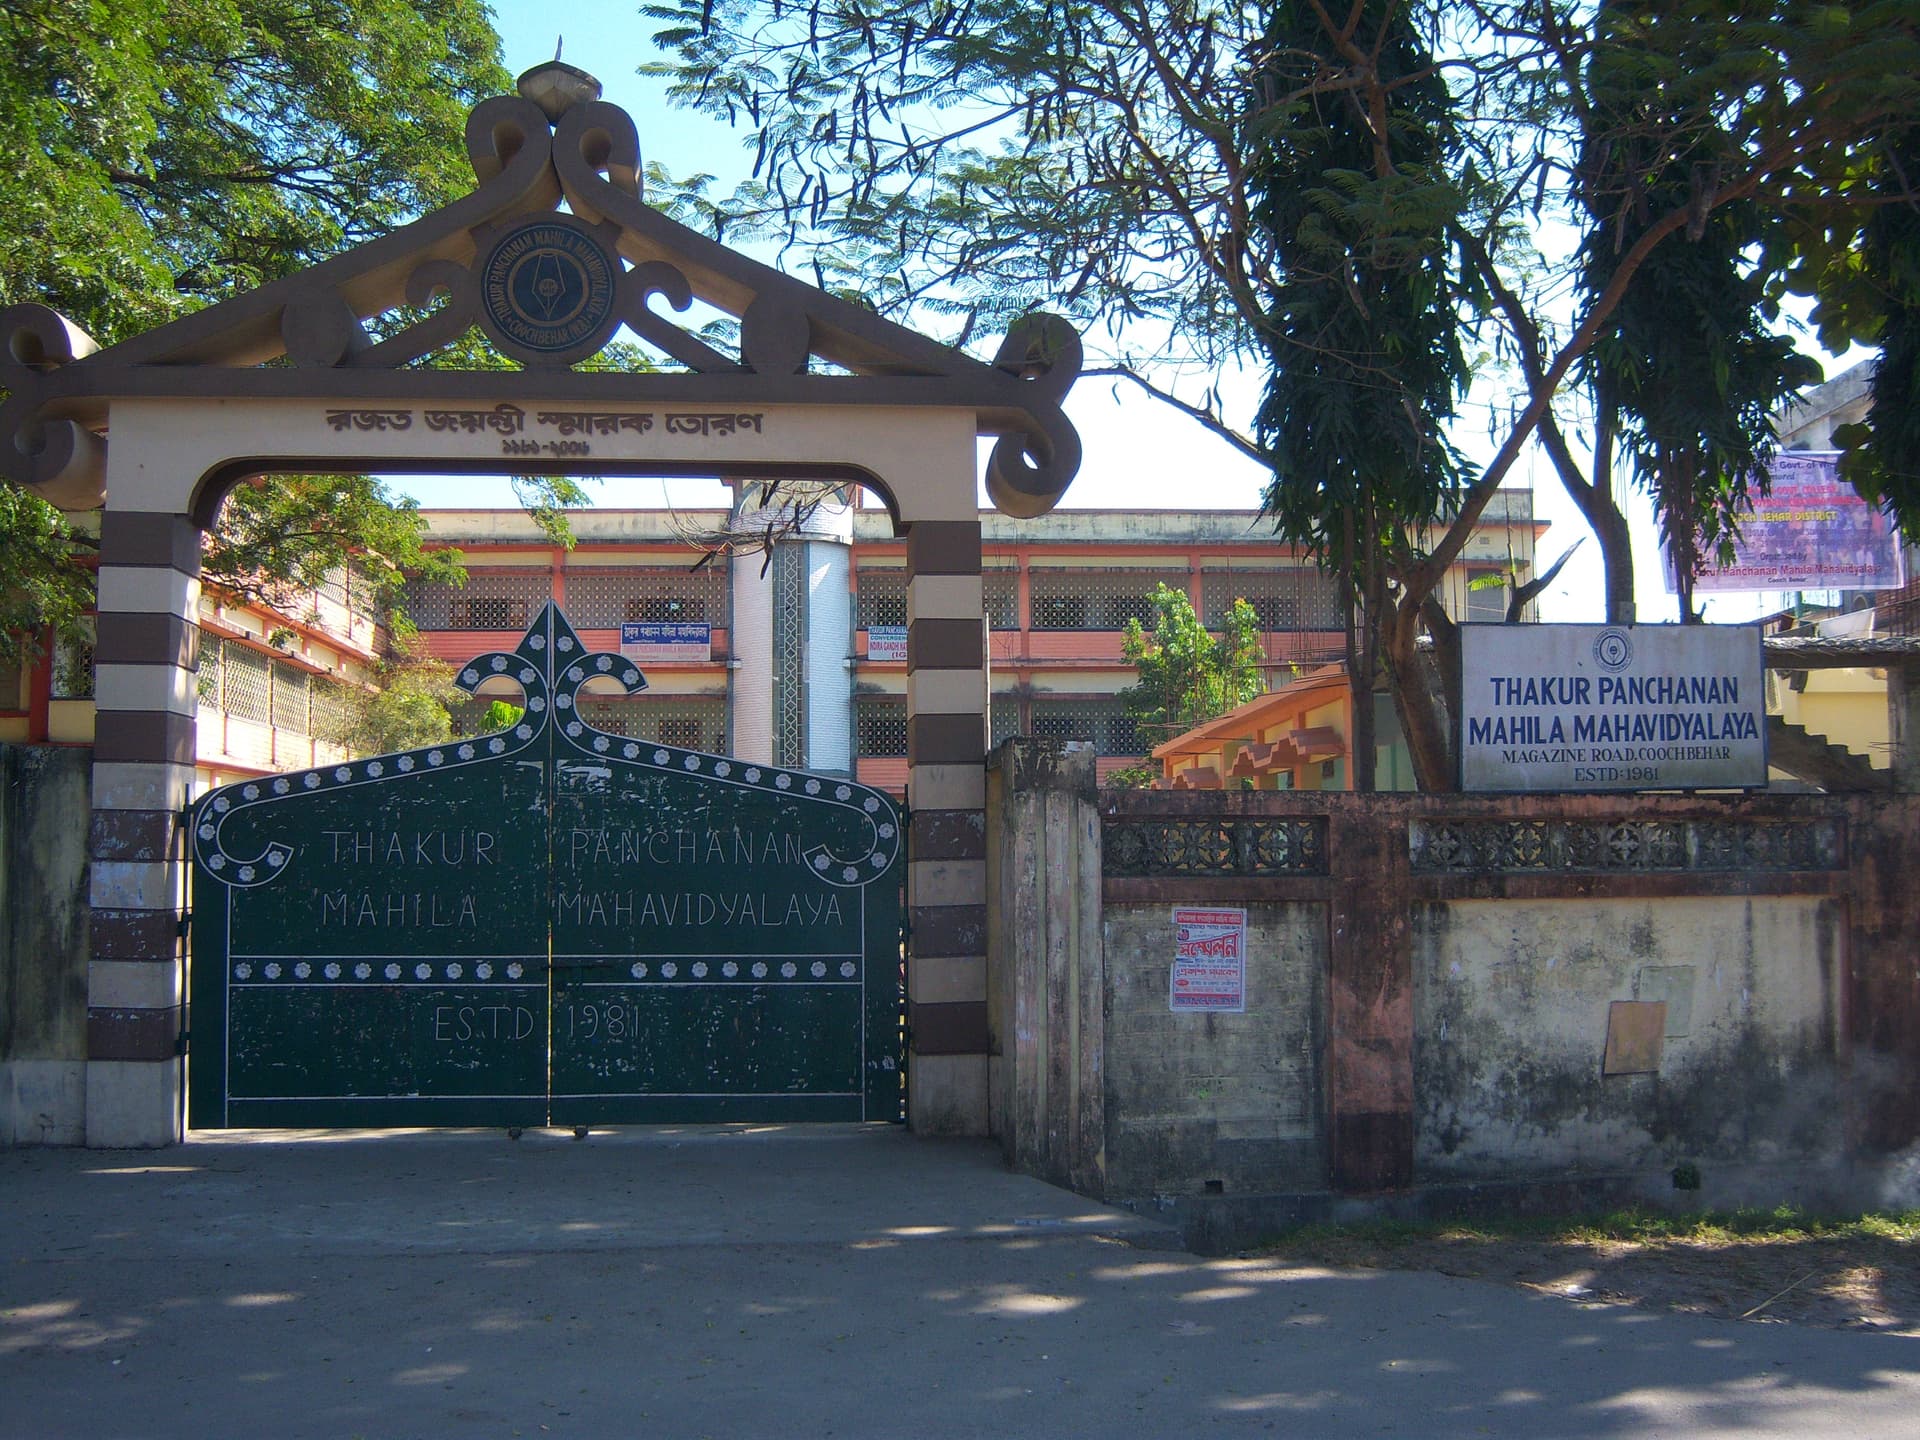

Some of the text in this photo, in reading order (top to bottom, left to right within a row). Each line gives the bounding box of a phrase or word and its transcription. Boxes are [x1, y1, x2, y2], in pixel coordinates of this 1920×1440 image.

[326, 403, 764, 436] রজত জয়ন্তী স্মারক তোরণ
[1490, 676, 1739, 706] THAKUR PANCHANAN
[1469, 712, 1759, 746] MAHILA MAHAVIDYALAYA
[1502, 748, 1586, 764] MAGAZINE
[321, 831, 802, 866] THAKUR PANCHANAN
[323, 893, 843, 927] MAHILA MAHAVIDYALAYA
[568, 1004, 640, 1039] 1981
